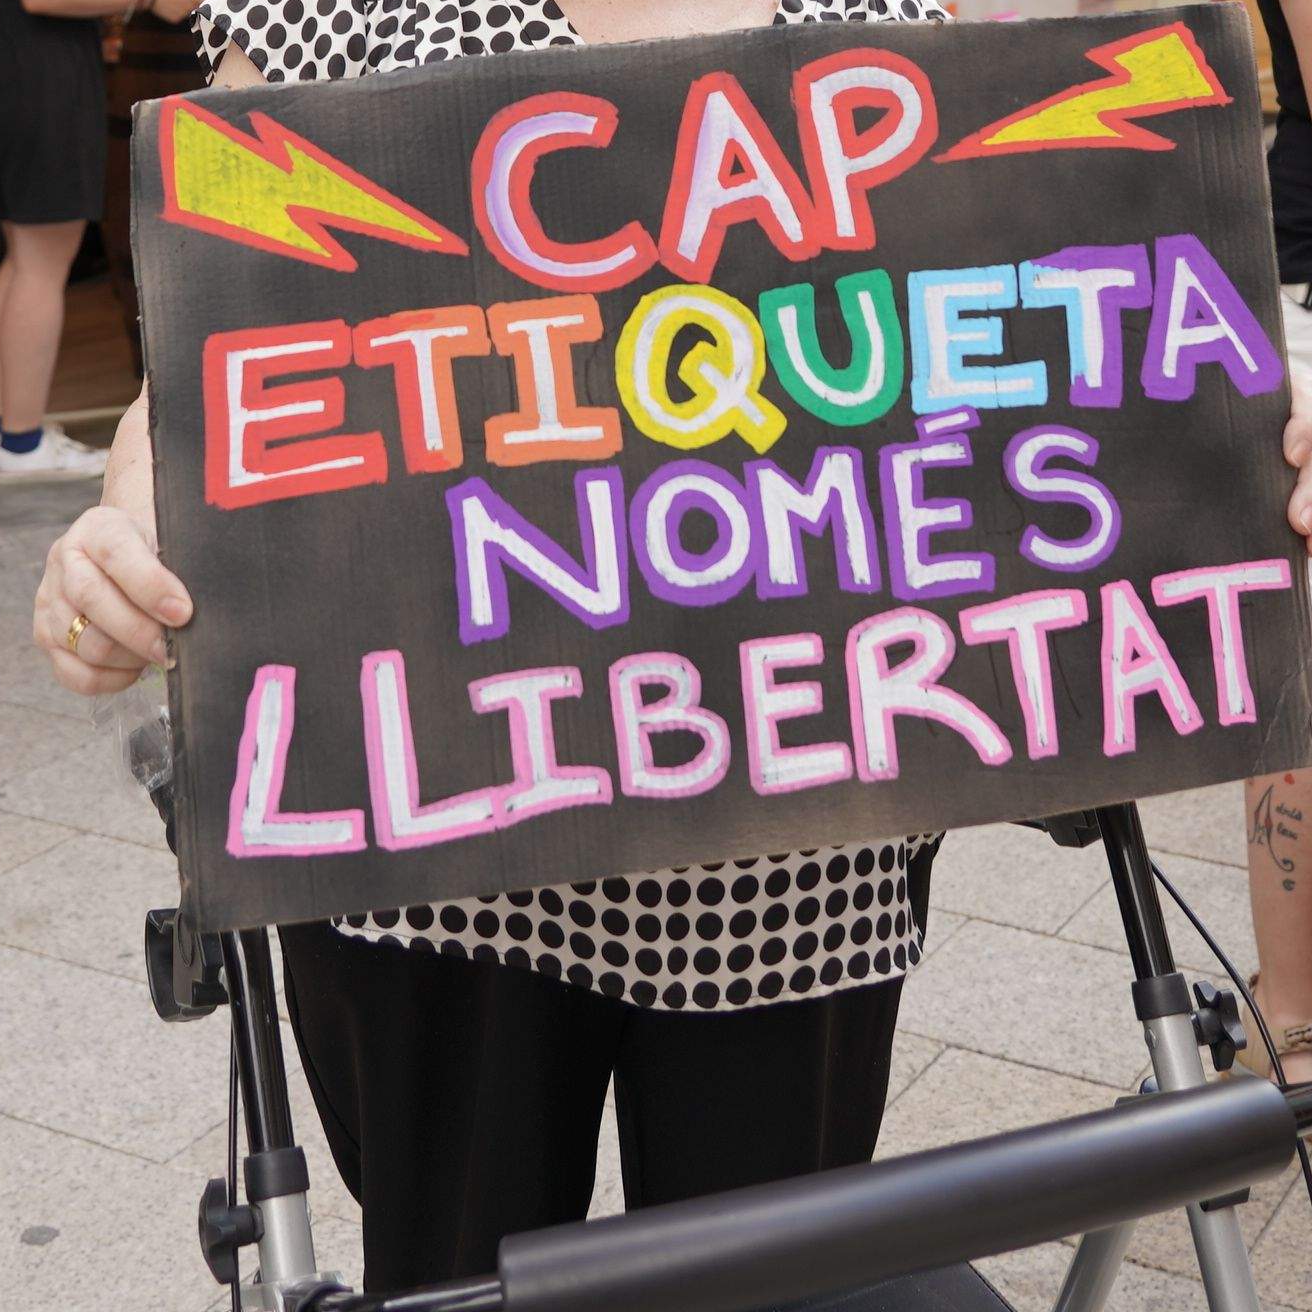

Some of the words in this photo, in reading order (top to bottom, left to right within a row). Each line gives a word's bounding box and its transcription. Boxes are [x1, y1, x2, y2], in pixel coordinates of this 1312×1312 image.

[471, 47, 938, 286] CAP
[204, 233, 1285, 508] ETIQUETA
[444, 405, 1124, 644] NOMÉS
[225, 558, 1291, 857] LLIBERTAT
